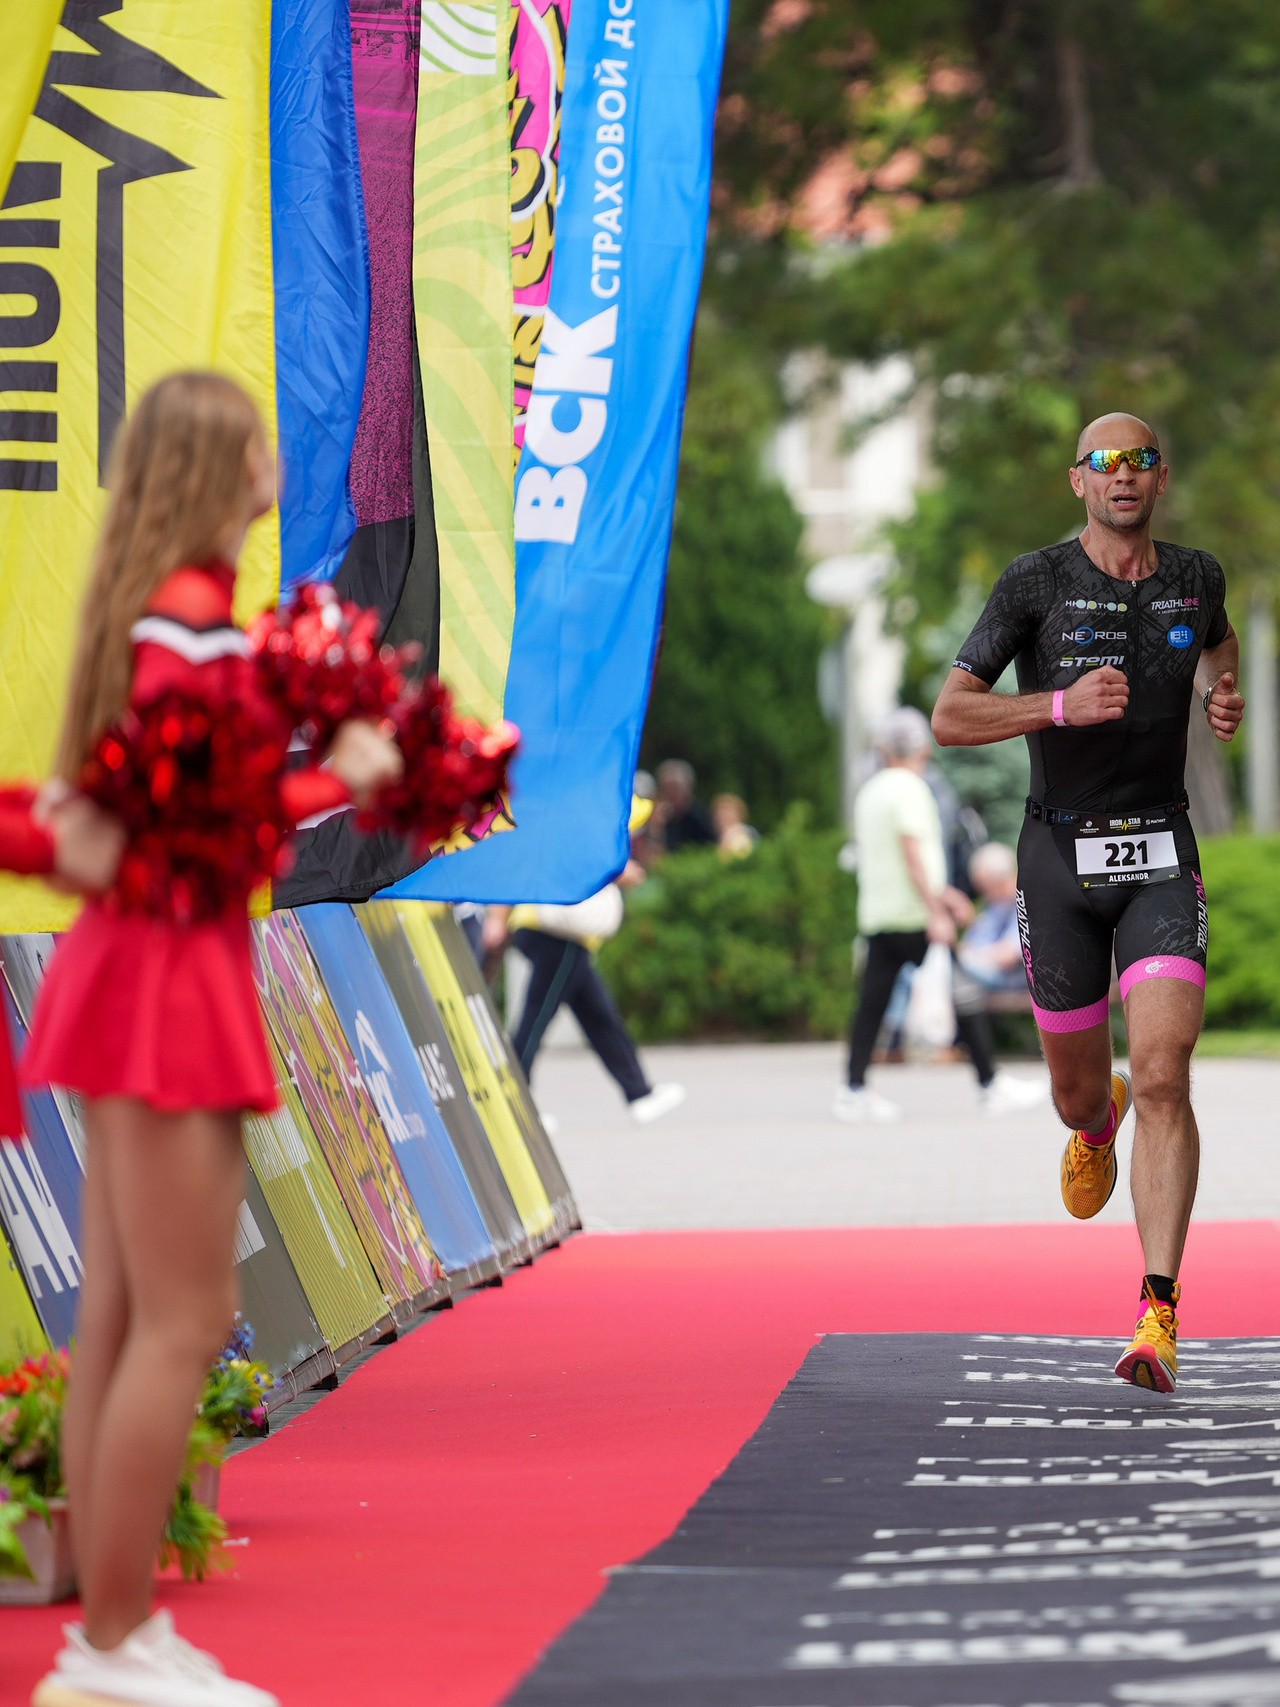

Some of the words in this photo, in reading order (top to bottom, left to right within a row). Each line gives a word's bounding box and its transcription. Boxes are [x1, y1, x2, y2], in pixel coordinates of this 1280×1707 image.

[514, 303, 620, 545] ВСК
[590, 60, 629, 300] СТРАХОВОЙ
[1109, 819, 1123, 827] IRON
[1127, 817, 1141, 825] STAR
[1104, 840, 1148, 867] 221
[1108, 872, 1150, 882] ALEKSANDR
[942, 1416, 1213, 1427] IRON
